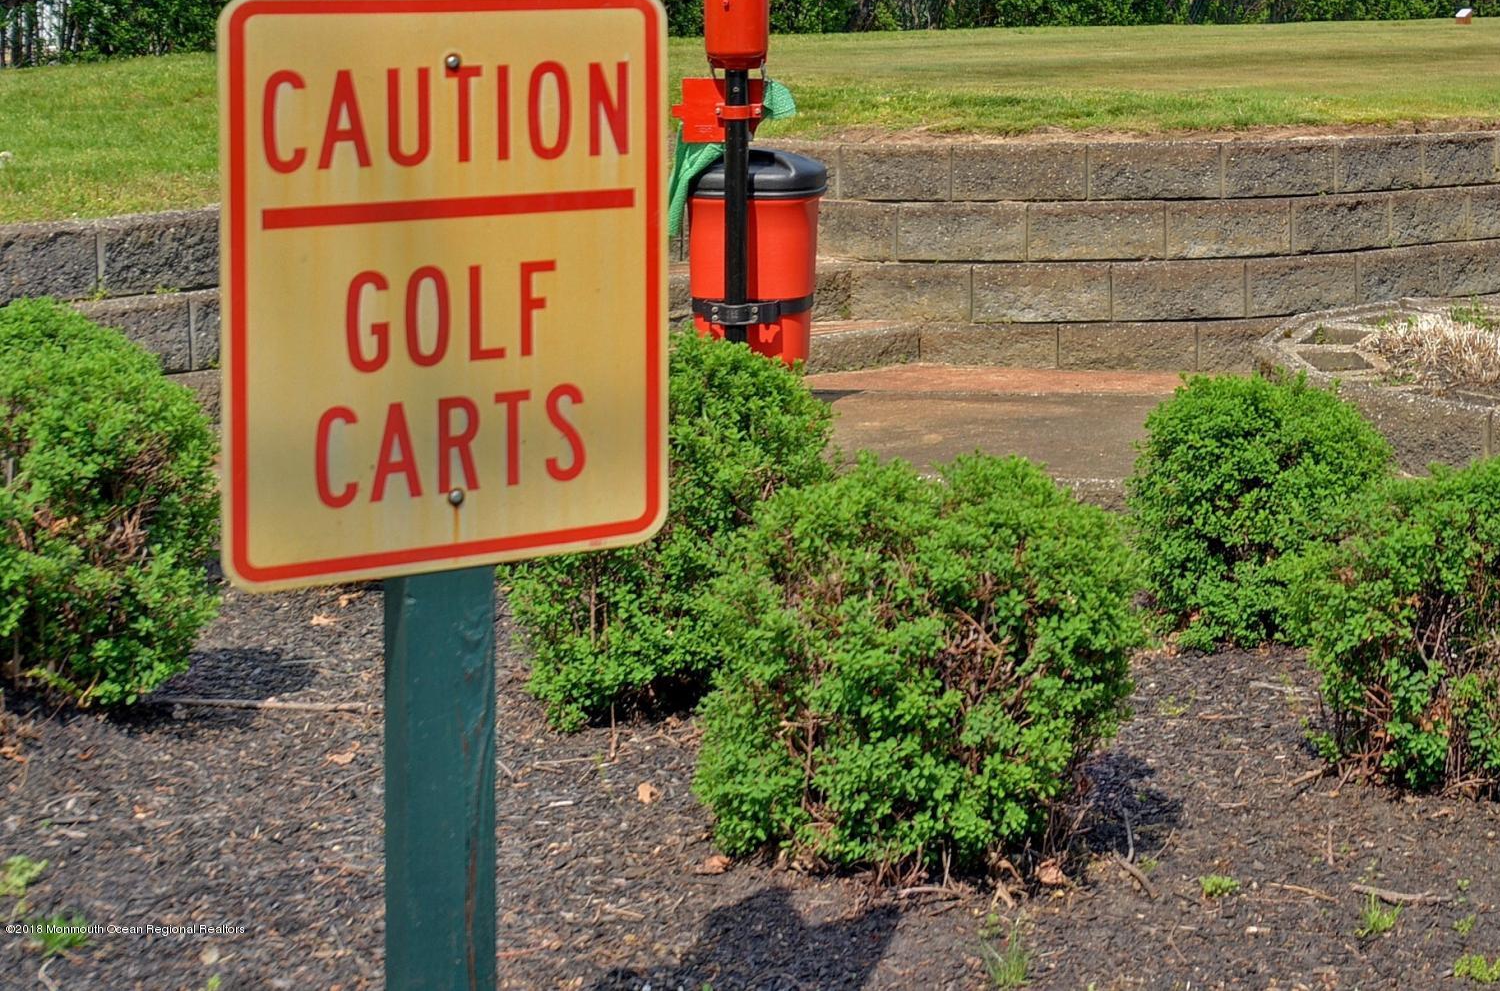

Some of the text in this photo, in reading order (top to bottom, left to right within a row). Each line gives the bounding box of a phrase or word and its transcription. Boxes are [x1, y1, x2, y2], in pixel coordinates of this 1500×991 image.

[261, 60, 630, 174] CAUTION
[345, 259, 557, 373] GOLF
[315, 383, 587, 509] CARTS
